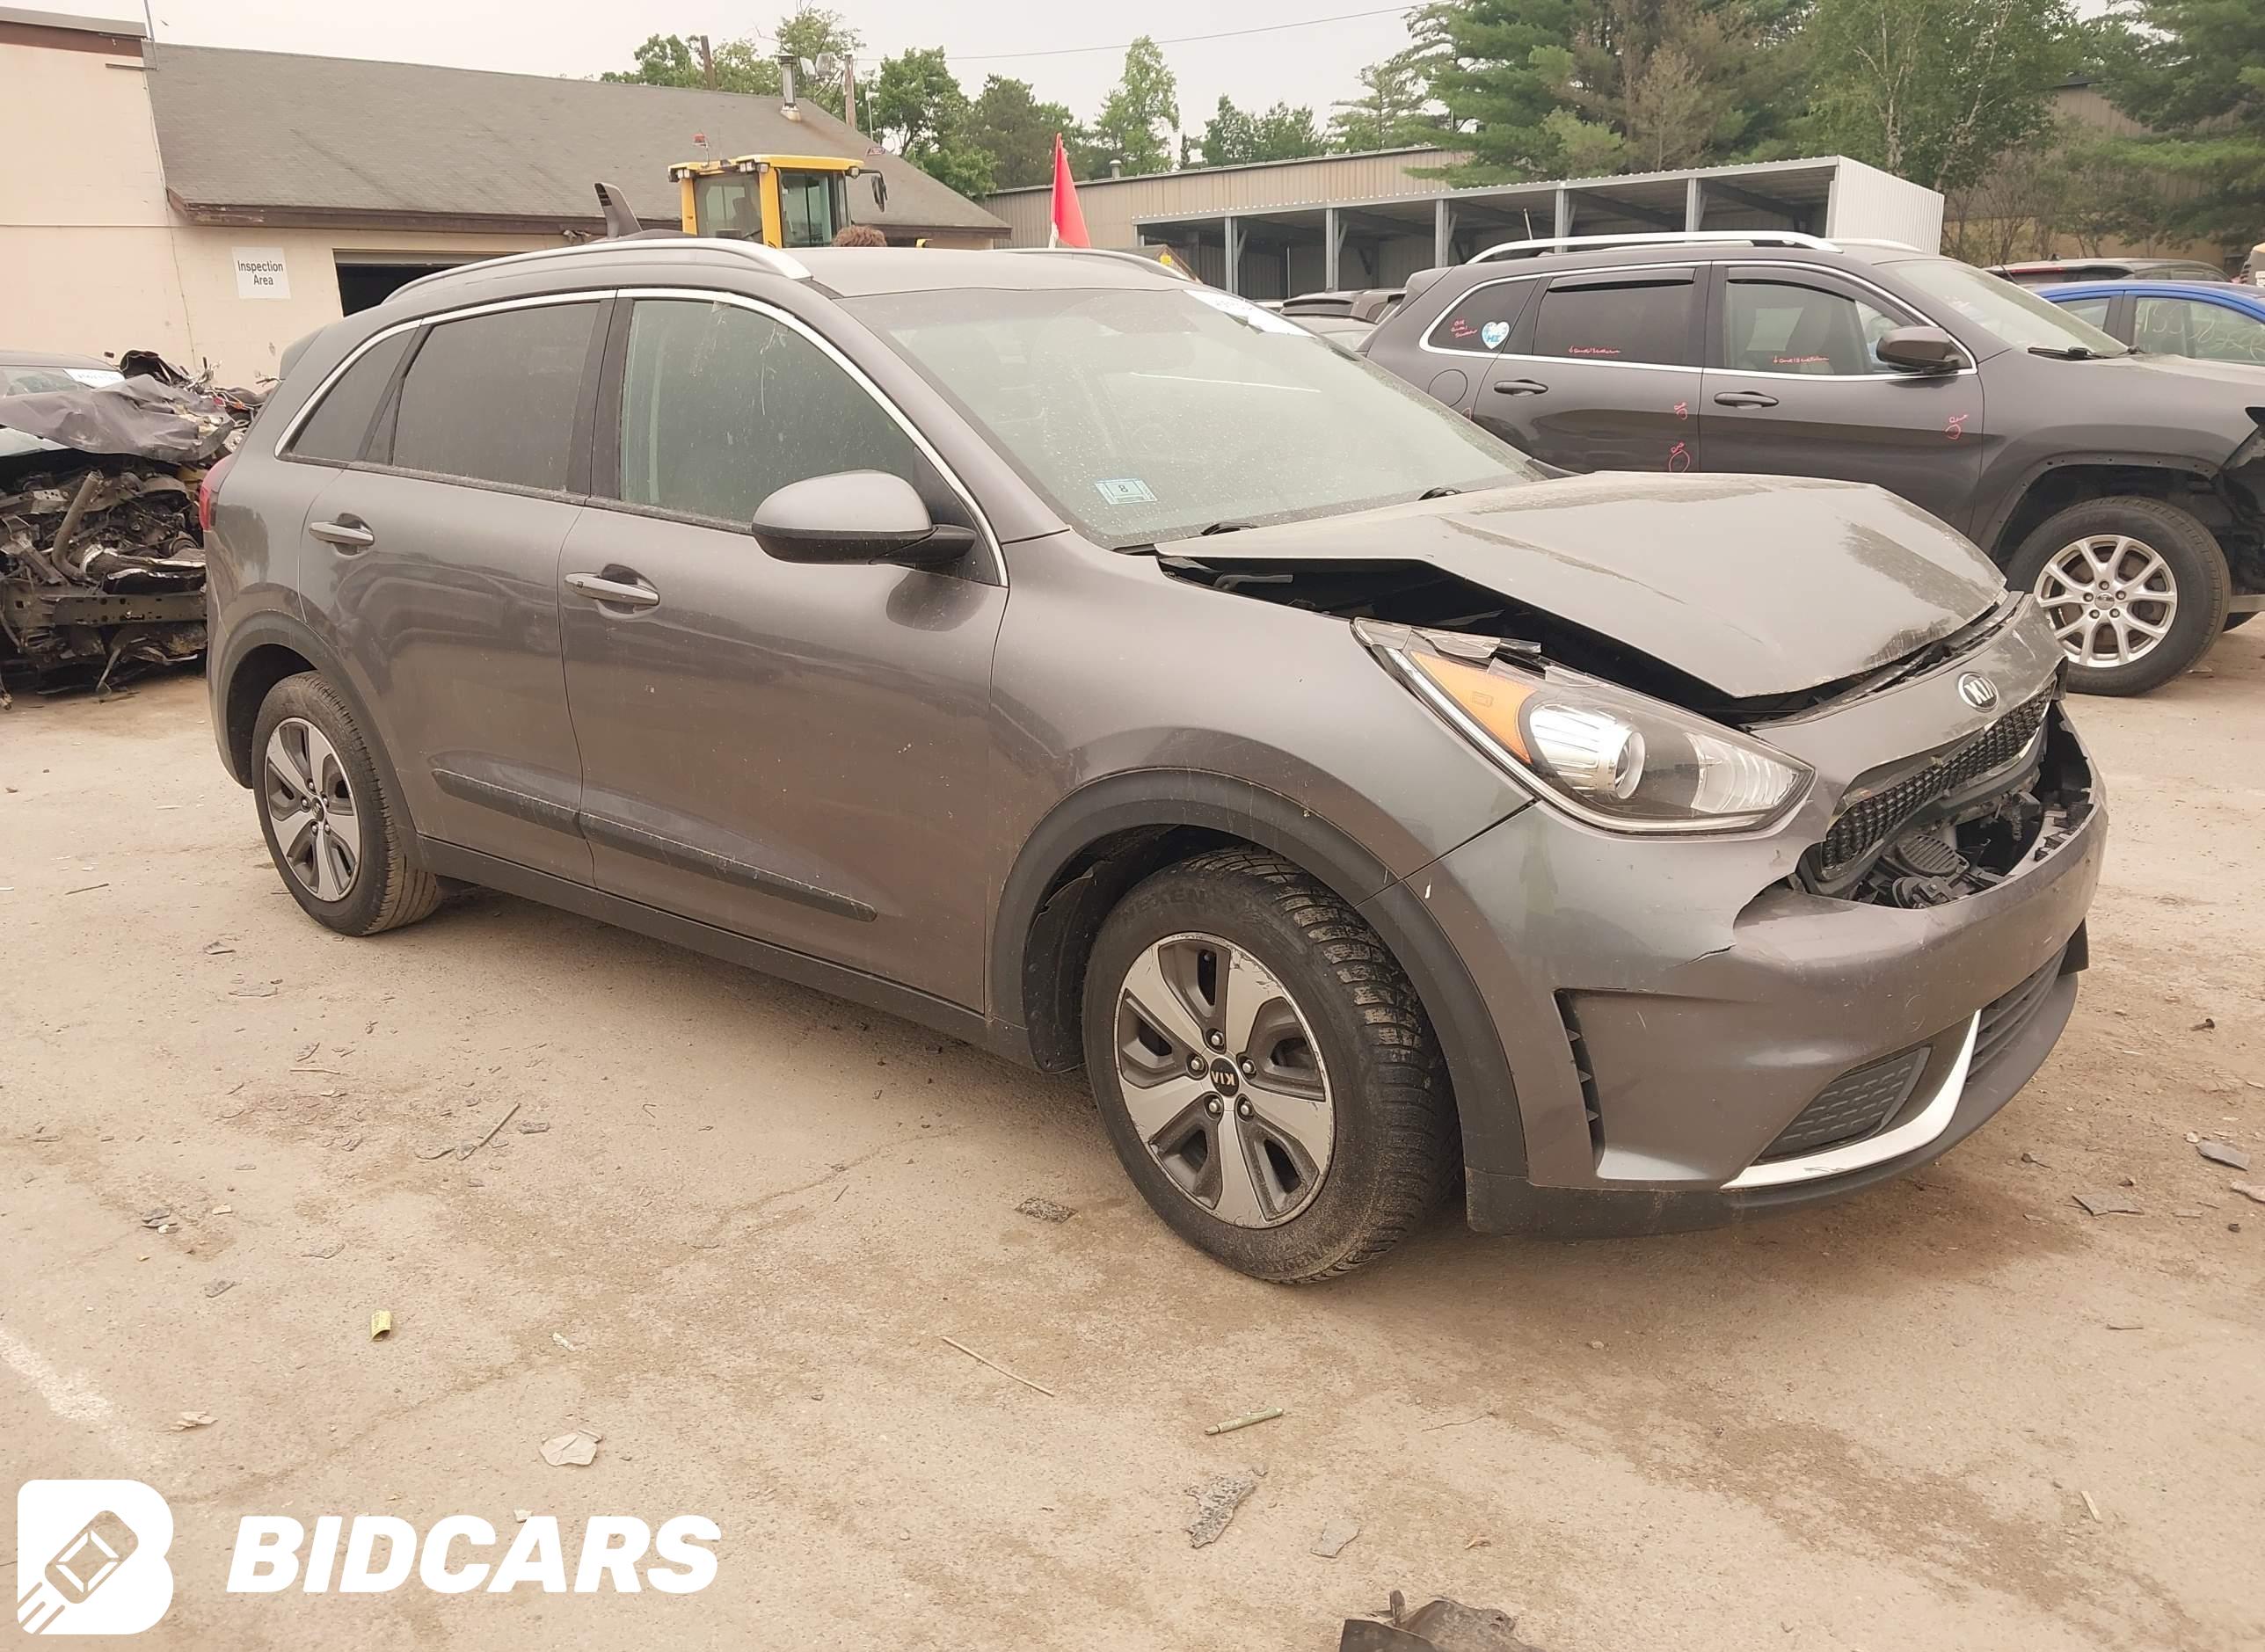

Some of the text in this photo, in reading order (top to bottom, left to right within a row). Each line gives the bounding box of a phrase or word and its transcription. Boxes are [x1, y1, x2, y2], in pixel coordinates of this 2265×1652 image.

[237, 260, 284, 273] Inspection
[253, 274, 273, 286] Area
[1118, 484, 1129, 493] 8
[1963, 677, 1994, 705] KIA
[1211, 1071, 1235, 1087] KIA
